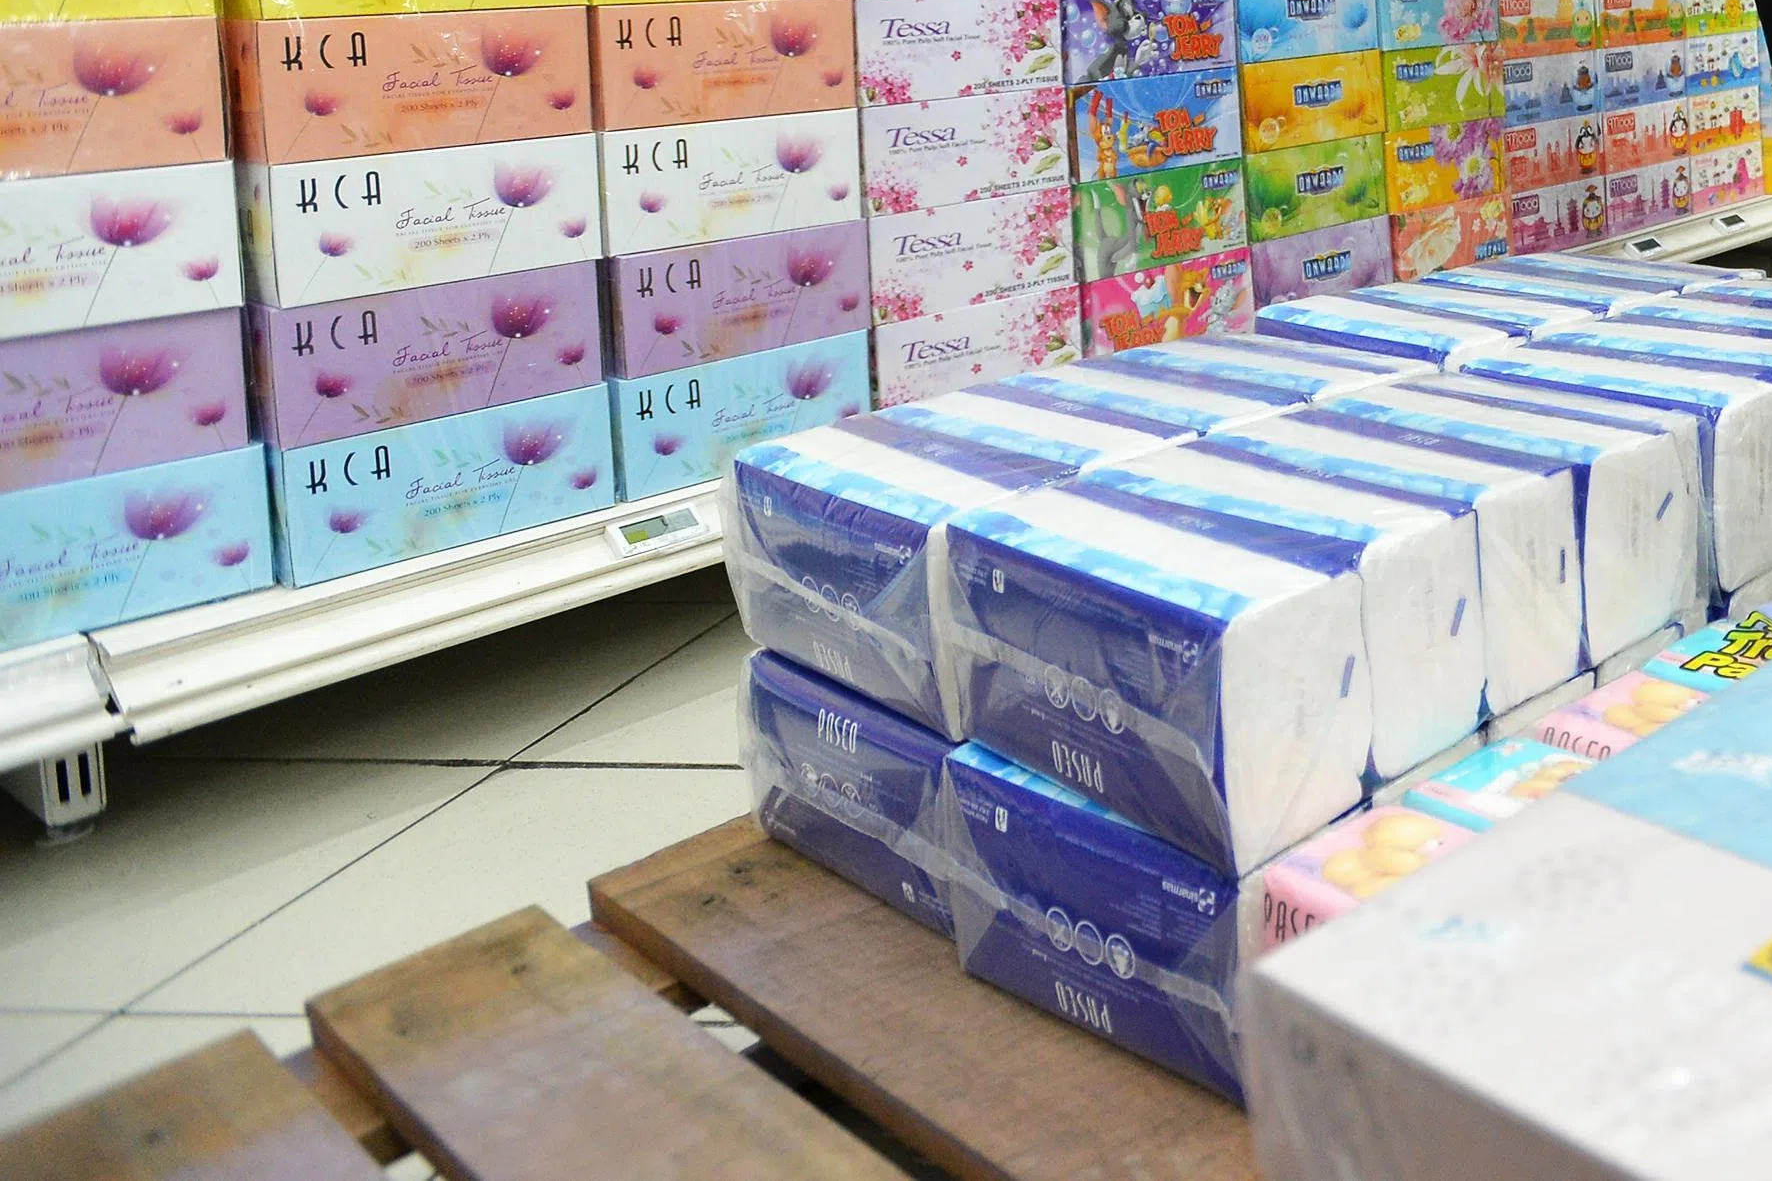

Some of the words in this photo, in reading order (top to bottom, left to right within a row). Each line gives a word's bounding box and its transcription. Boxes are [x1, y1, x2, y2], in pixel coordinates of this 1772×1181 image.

[616, 16, 681, 50] KCA
[880, 18, 950, 39] Tessa
[1163, 14, 1198, 36] TOM
[280, 32, 367, 71] KCA
[1170, 32, 1223, 61] JERRY
[382, 71, 440, 92] Facial
[451, 65, 493, 83] Tissue
[1294, 81, 1342, 104] ONWARDS
[1154, 108, 1191, 131] TOM
[887, 126, 956, 149] Tessa
[1163, 126, 1217, 156] JERRY
[623, 138, 688, 175] KCA
[296, 170, 381, 214] KCA
[980, 186, 991, 194] 200
[992, 182, 1020, 192] SHEETS
[1041, 175, 1065, 184] TISSUE
[396, 206, 454, 230] Facial
[464, 197, 506, 219] Tissue
[1144, 211, 1180, 235] TOM
[893, 231, 961, 256] Tessa
[1152, 225, 1205, 259] JERRY
[637, 258, 701, 298] KCA
[1303, 252, 1352, 280] ONWARDS
[985, 288, 998, 297] 200
[998, 283, 1025, 294] SHEETS
[1047, 274, 1070, 285] TISSUE
[291, 310, 378, 357] KCA
[1102, 312, 1141, 340] TOM
[393, 344, 450, 367] Facial
[460, 331, 503, 353] Tissue
[901, 335, 970, 364] Tessa
[637, 379, 701, 421] KCA
[305, 445, 391, 495] KCA
[405, 475, 462, 500] Facial
[474, 458, 516, 479] Tissue
[817, 707, 862, 754] PASEO
[1051, 740, 1105, 794] PASEO
[1162, 880, 1199, 903] sinarmas
[1054, 980, 1114, 1034] PASEO
